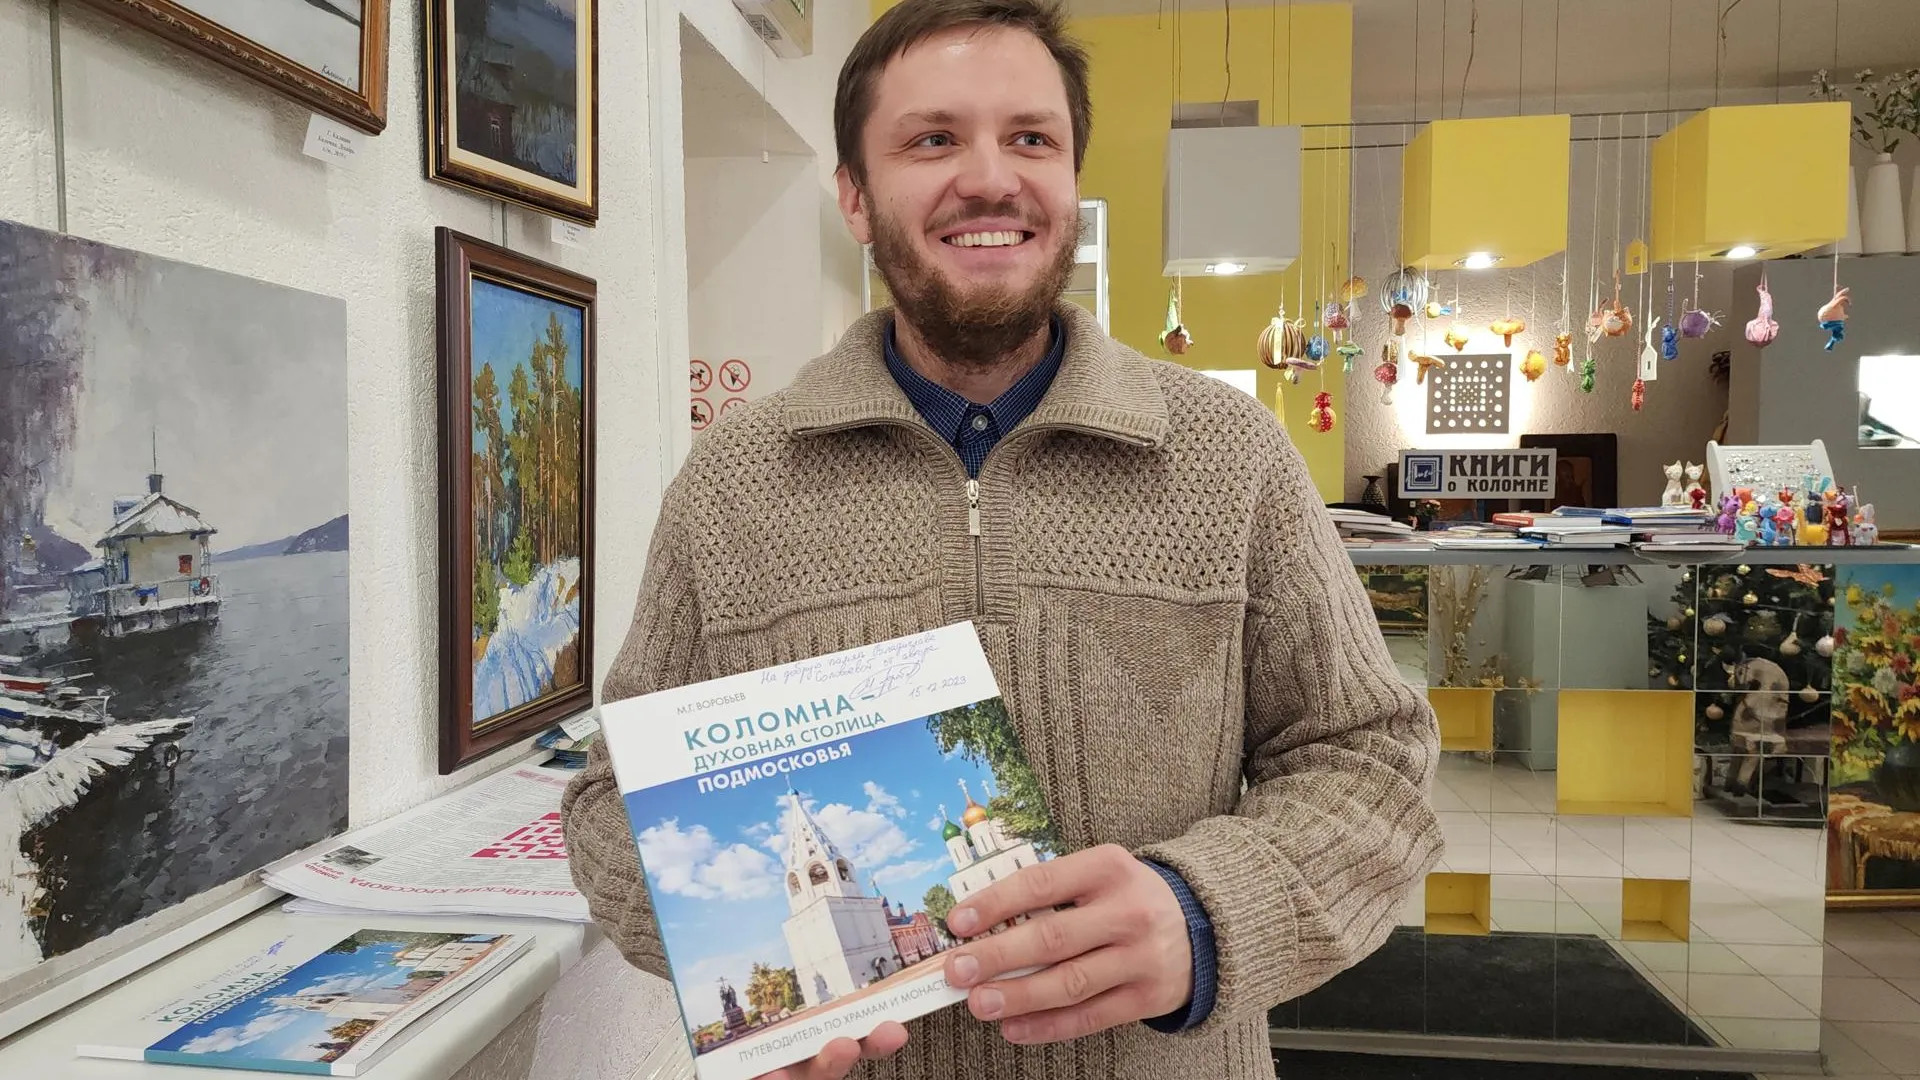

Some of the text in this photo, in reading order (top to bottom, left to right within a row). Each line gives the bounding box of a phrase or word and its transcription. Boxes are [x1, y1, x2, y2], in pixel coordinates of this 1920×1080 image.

[1450, 454, 1549, 477] КНИГИ
[1467, 479, 1549, 492] КОЛОМНЕ
[684, 694, 856, 750] КОЛОМНА
[696, 692, 746, 710] ВОРОБЬЕВ
[694, 711, 886, 772] ДУХОВНАЯ СТОЛИЦА
[697, 742, 853, 794] ПОДМОСКОВЬЯ
[157, 971, 269, 1023] КОЛОМНА
[738, 1026, 824, 1063] ПУТЕВОДИТЕЛЬ
[824, 1016, 842, 1032] ПО
[843, 1001, 889, 1026] ХРАМАМ
[890, 996, 900, 1008] И
